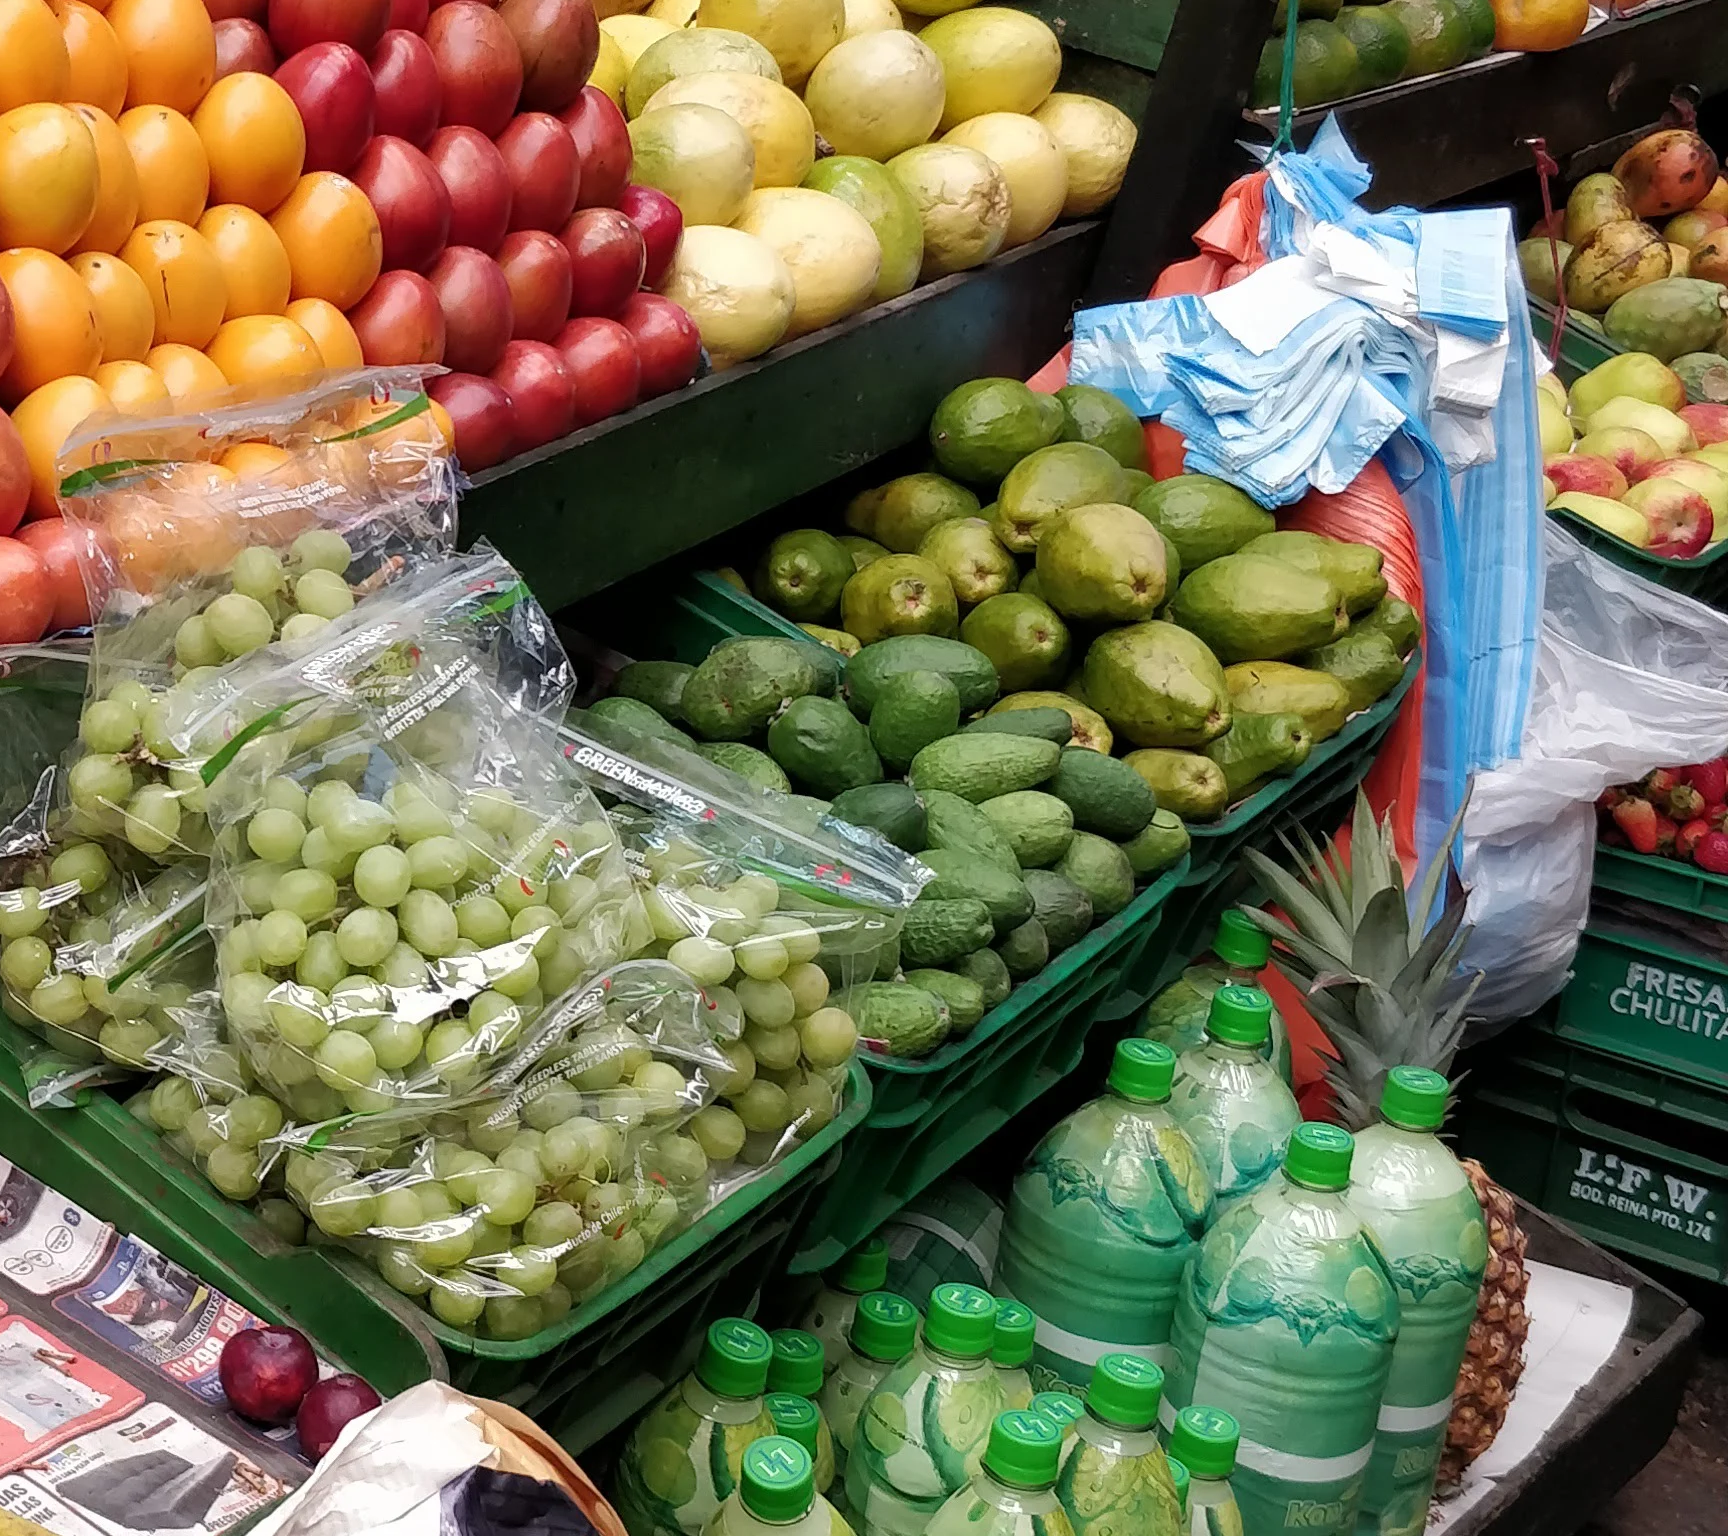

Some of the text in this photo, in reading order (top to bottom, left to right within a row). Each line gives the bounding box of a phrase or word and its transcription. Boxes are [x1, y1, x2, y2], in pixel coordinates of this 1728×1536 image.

[447, 881, 491, 911] roducto
[1607, 1191, 1649, 1220] REINA
[176, 1297, 224, 1354] BLACK DAYS
